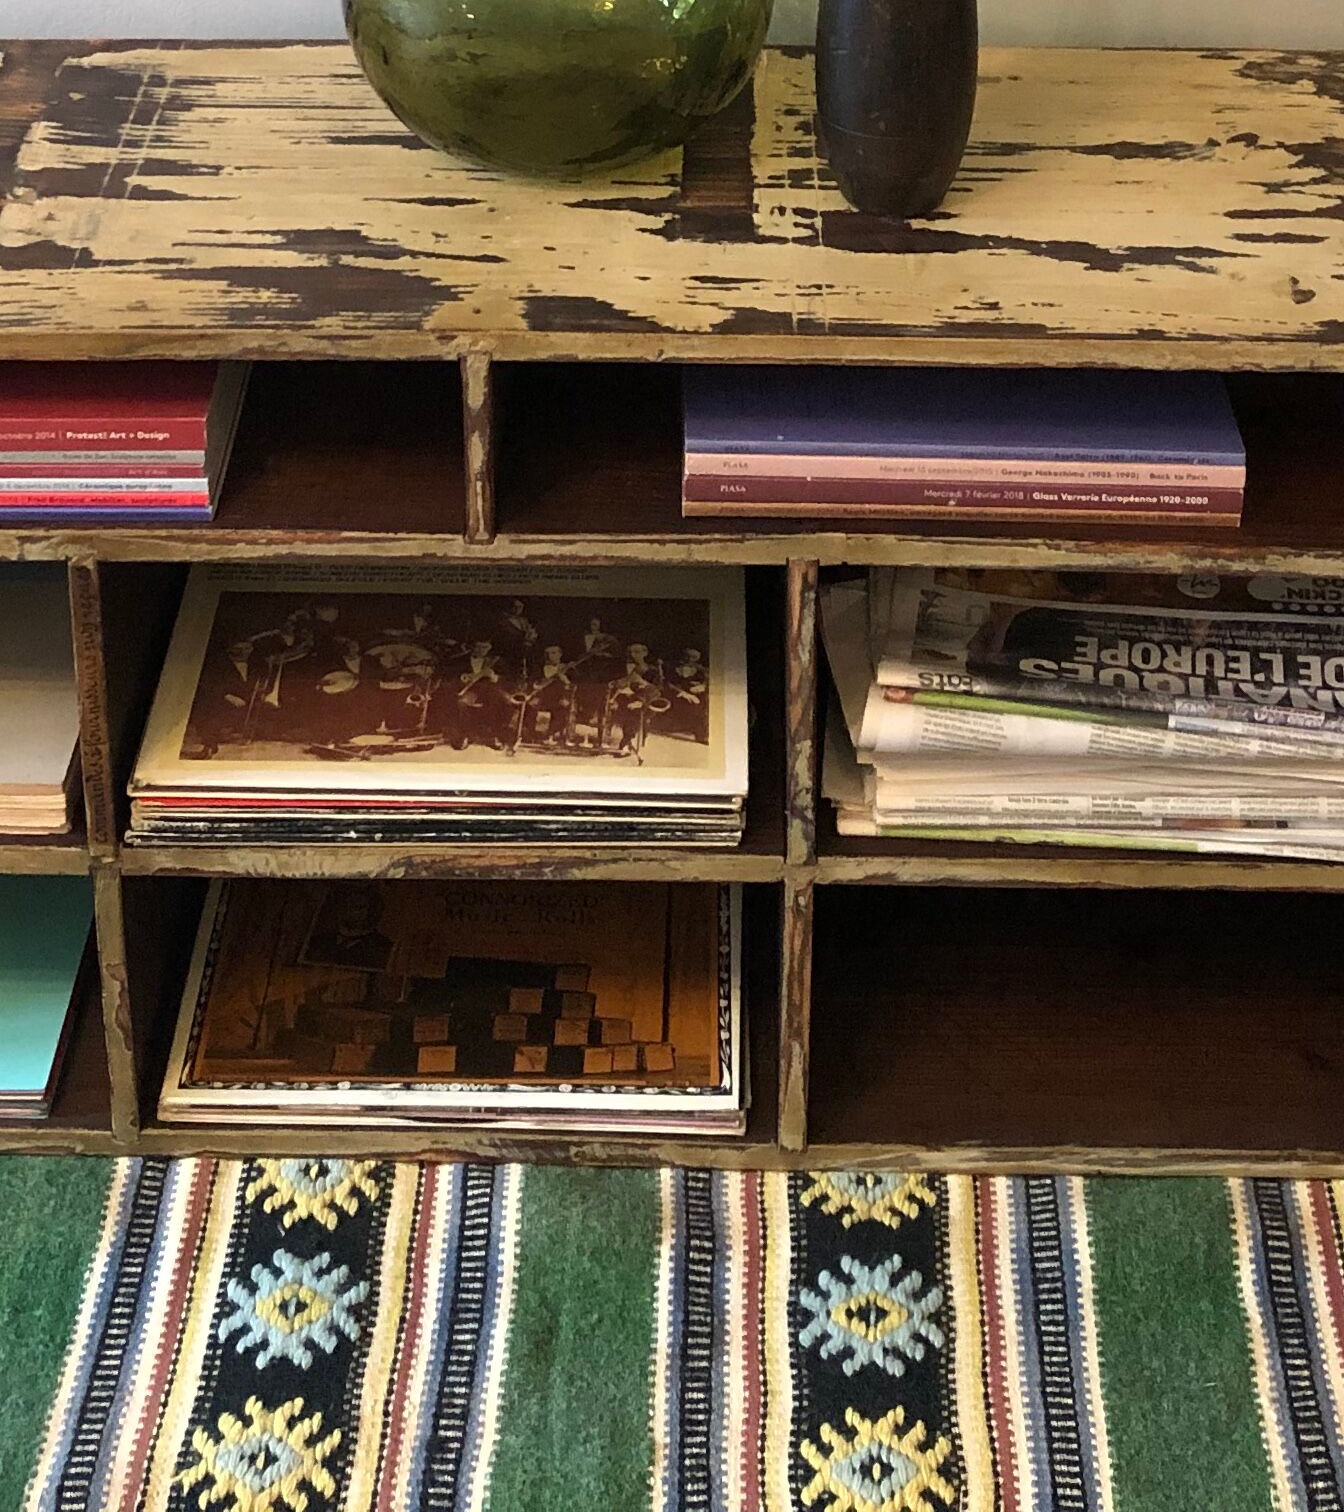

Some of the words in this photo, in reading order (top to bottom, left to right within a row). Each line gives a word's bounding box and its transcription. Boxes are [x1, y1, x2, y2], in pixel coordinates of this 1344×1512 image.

[109, 431, 126, 439] Art
[136, 430, 171, 441] Design
[924, 488, 962, 498] Mercredi
[972, 489, 1001, 499] février
[1003, 491, 1024, 500] 2018
[1032, 491, 1058, 501] Glass
[1073, 634, 1287, 685] L'EUROPE
